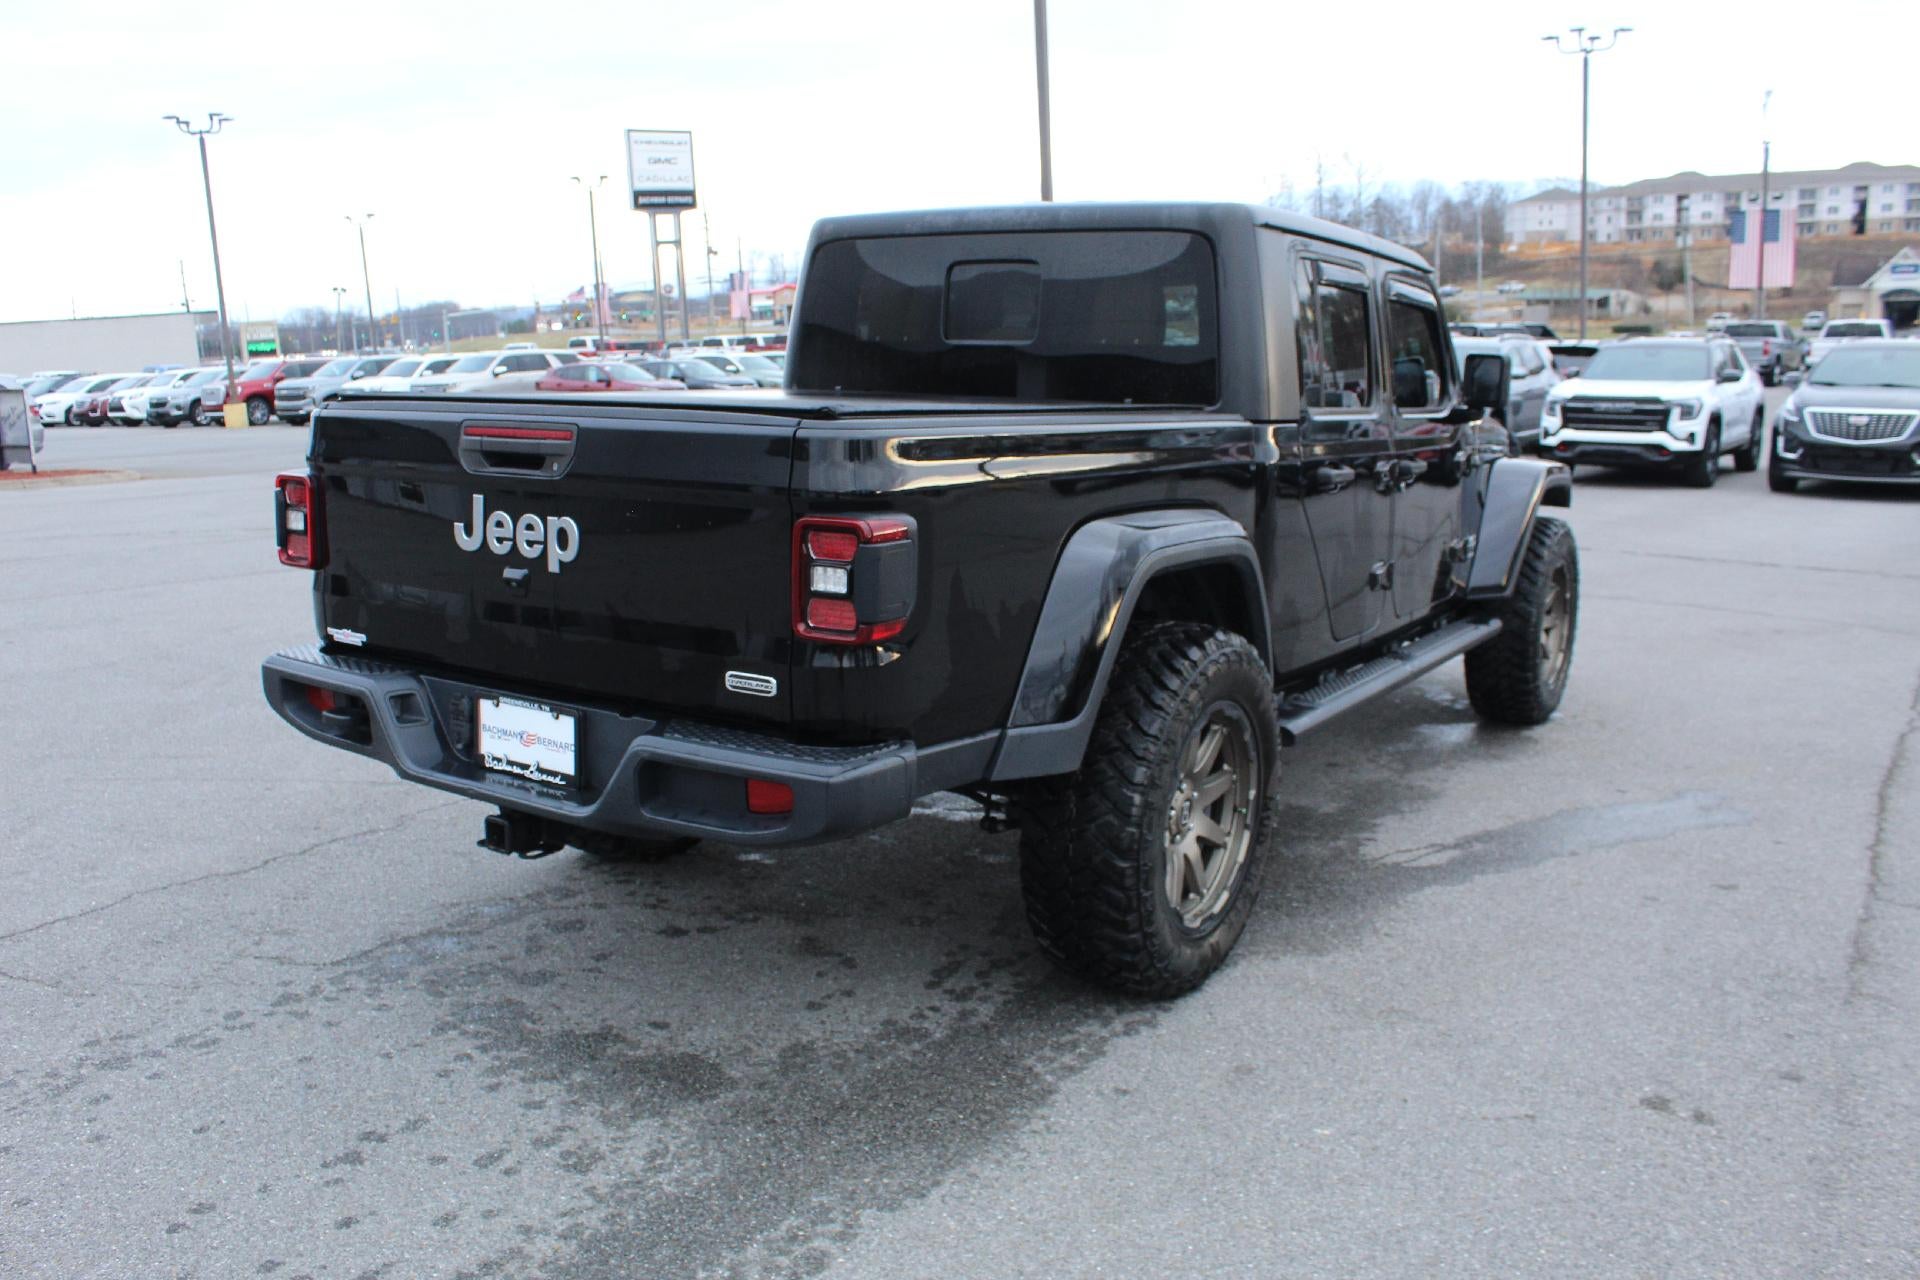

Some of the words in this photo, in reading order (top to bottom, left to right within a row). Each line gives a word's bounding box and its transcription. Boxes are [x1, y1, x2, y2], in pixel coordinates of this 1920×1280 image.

[648, 157, 678, 165] GMC
[454, 493, 579, 573] Jeep
[482, 724, 521, 740] BACHMAN
[537, 736, 575, 752] BERNARD
